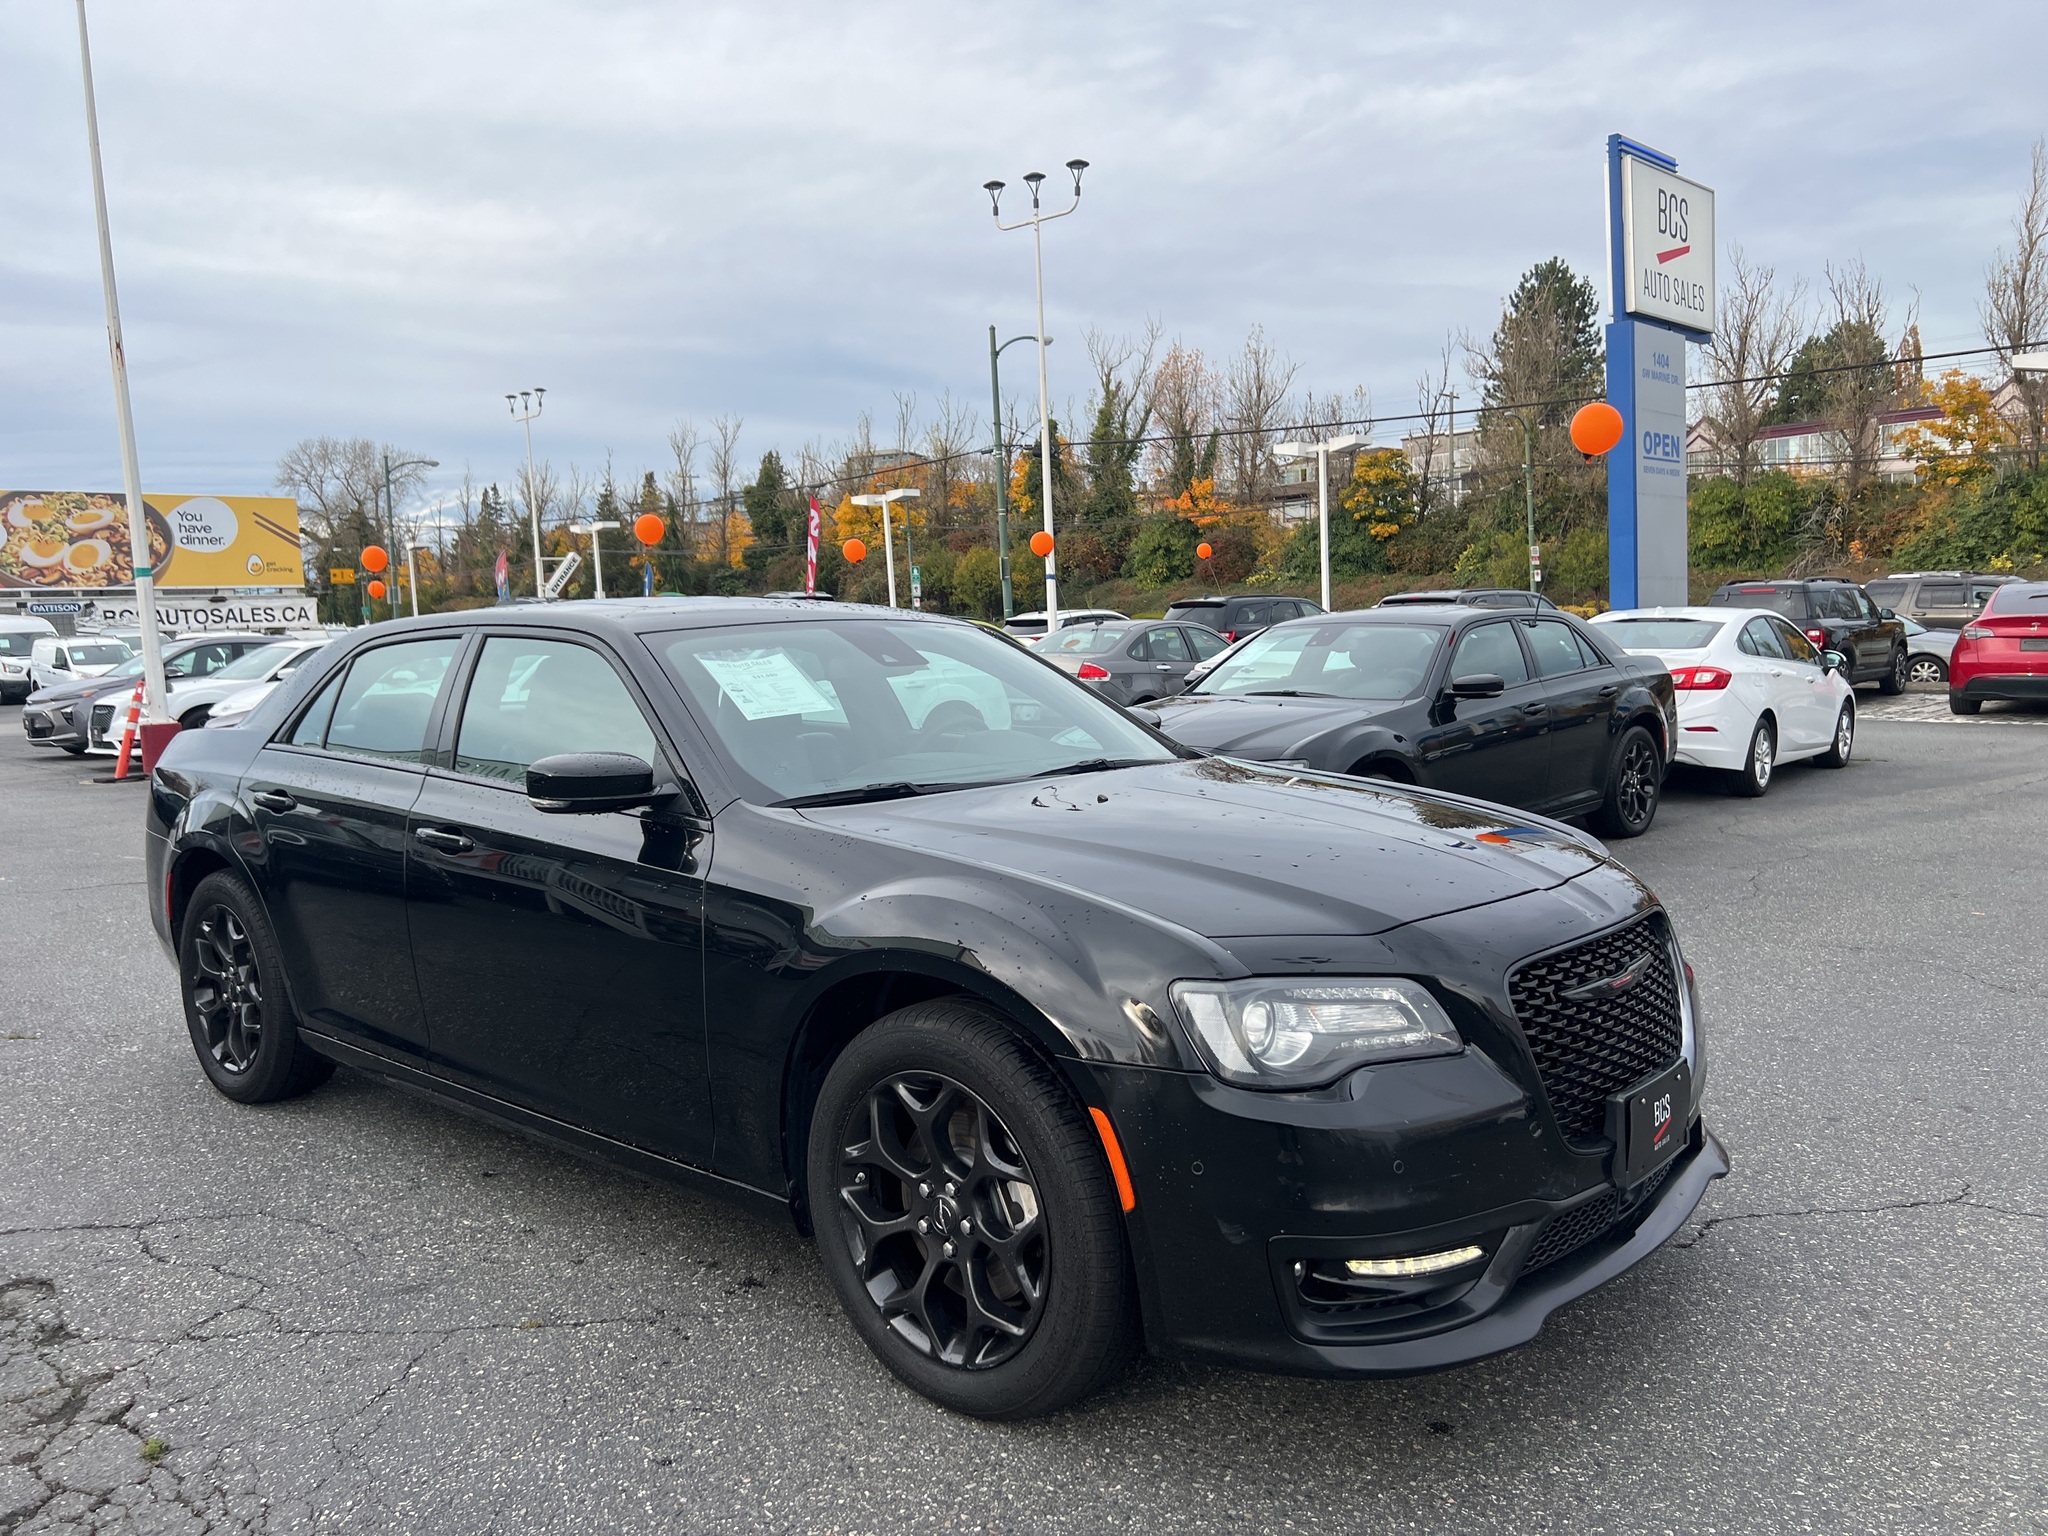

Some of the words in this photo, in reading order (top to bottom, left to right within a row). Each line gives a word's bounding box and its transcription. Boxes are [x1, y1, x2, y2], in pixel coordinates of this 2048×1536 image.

[1658, 188, 1688, 243] BCS
[1643, 268, 1670, 303] AUTO
[1673, 278, 1705, 312] SALES
[1653, 351, 1670, 369] 1404
[1651, 370, 1670, 384] MARINE
[1643, 431, 1680, 458] OPEN
[177, 510, 202, 522] You
[179, 523, 212, 534] have
[180, 534, 226, 546] dinner.
[551, 556, 579, 594] ENTRANCE
[32, 604, 79, 613] PATTISON
[1654, 1093, 1671, 1127] BCS
